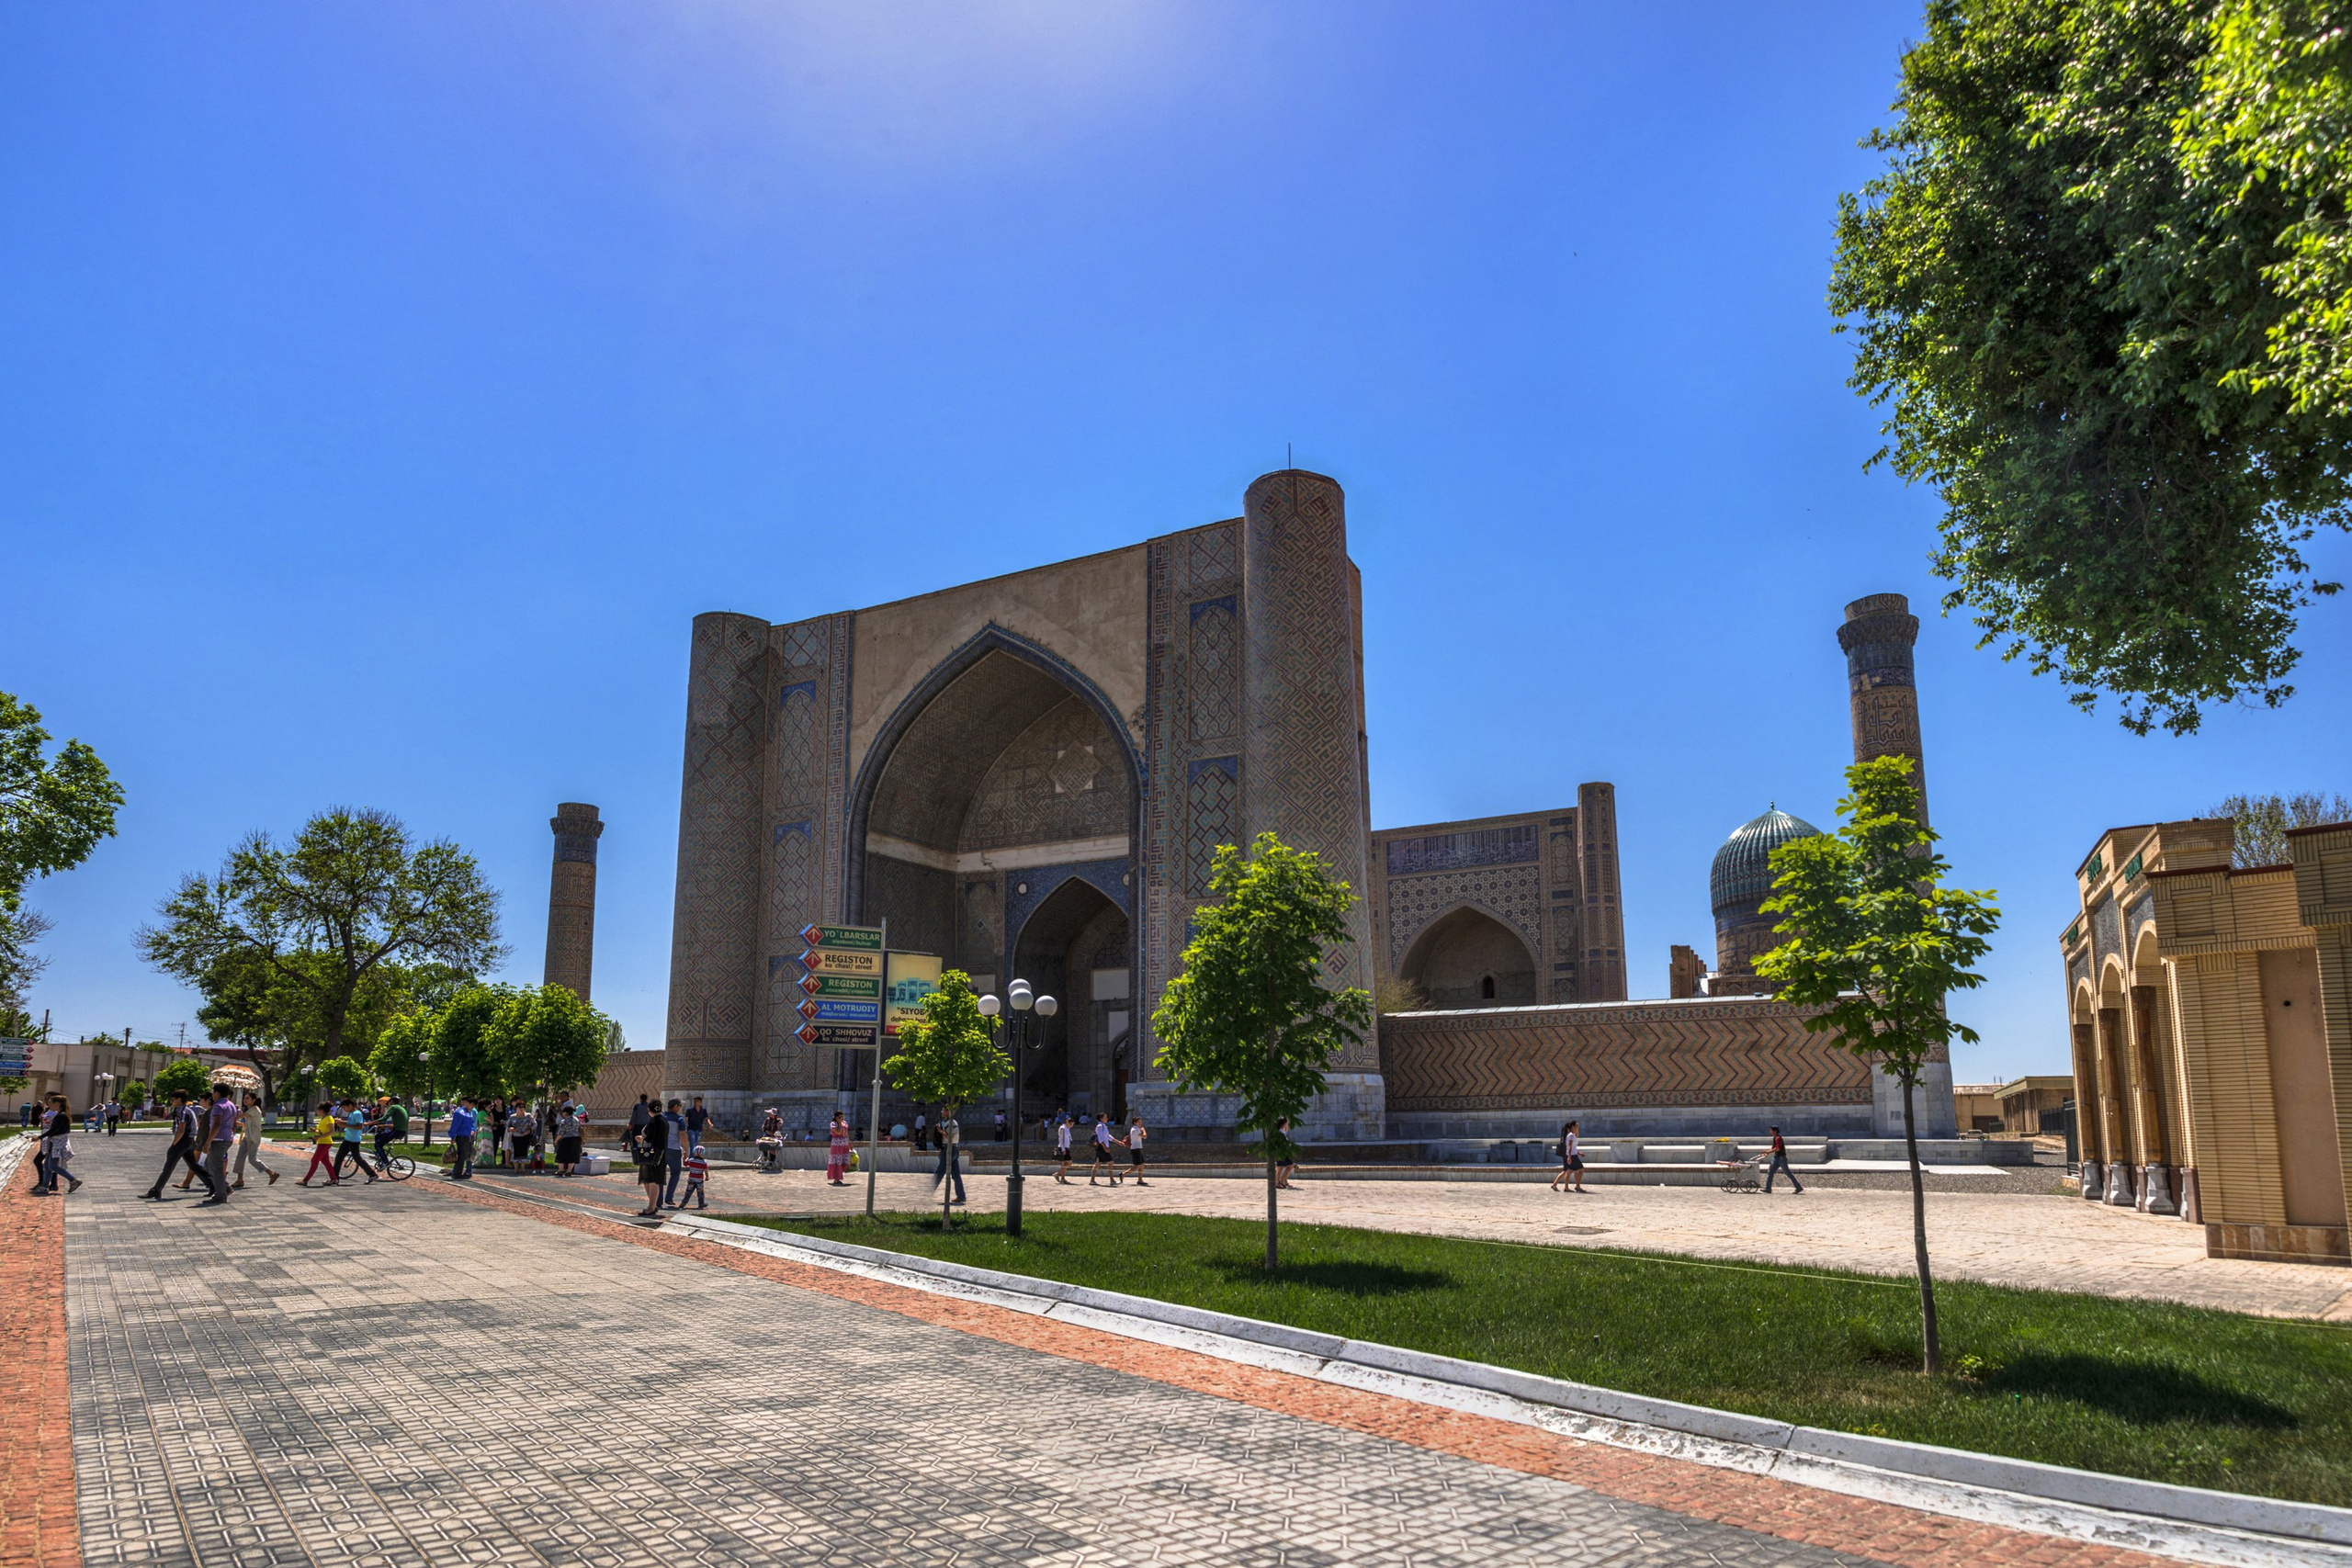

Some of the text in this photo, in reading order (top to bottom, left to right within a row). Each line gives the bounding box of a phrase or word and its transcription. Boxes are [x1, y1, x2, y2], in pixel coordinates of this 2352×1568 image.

[825, 954, 873, 964] REGISTON
[829, 978, 873, 988] REGISTON
[833, 1004, 876, 1012] MOTRUDIY
